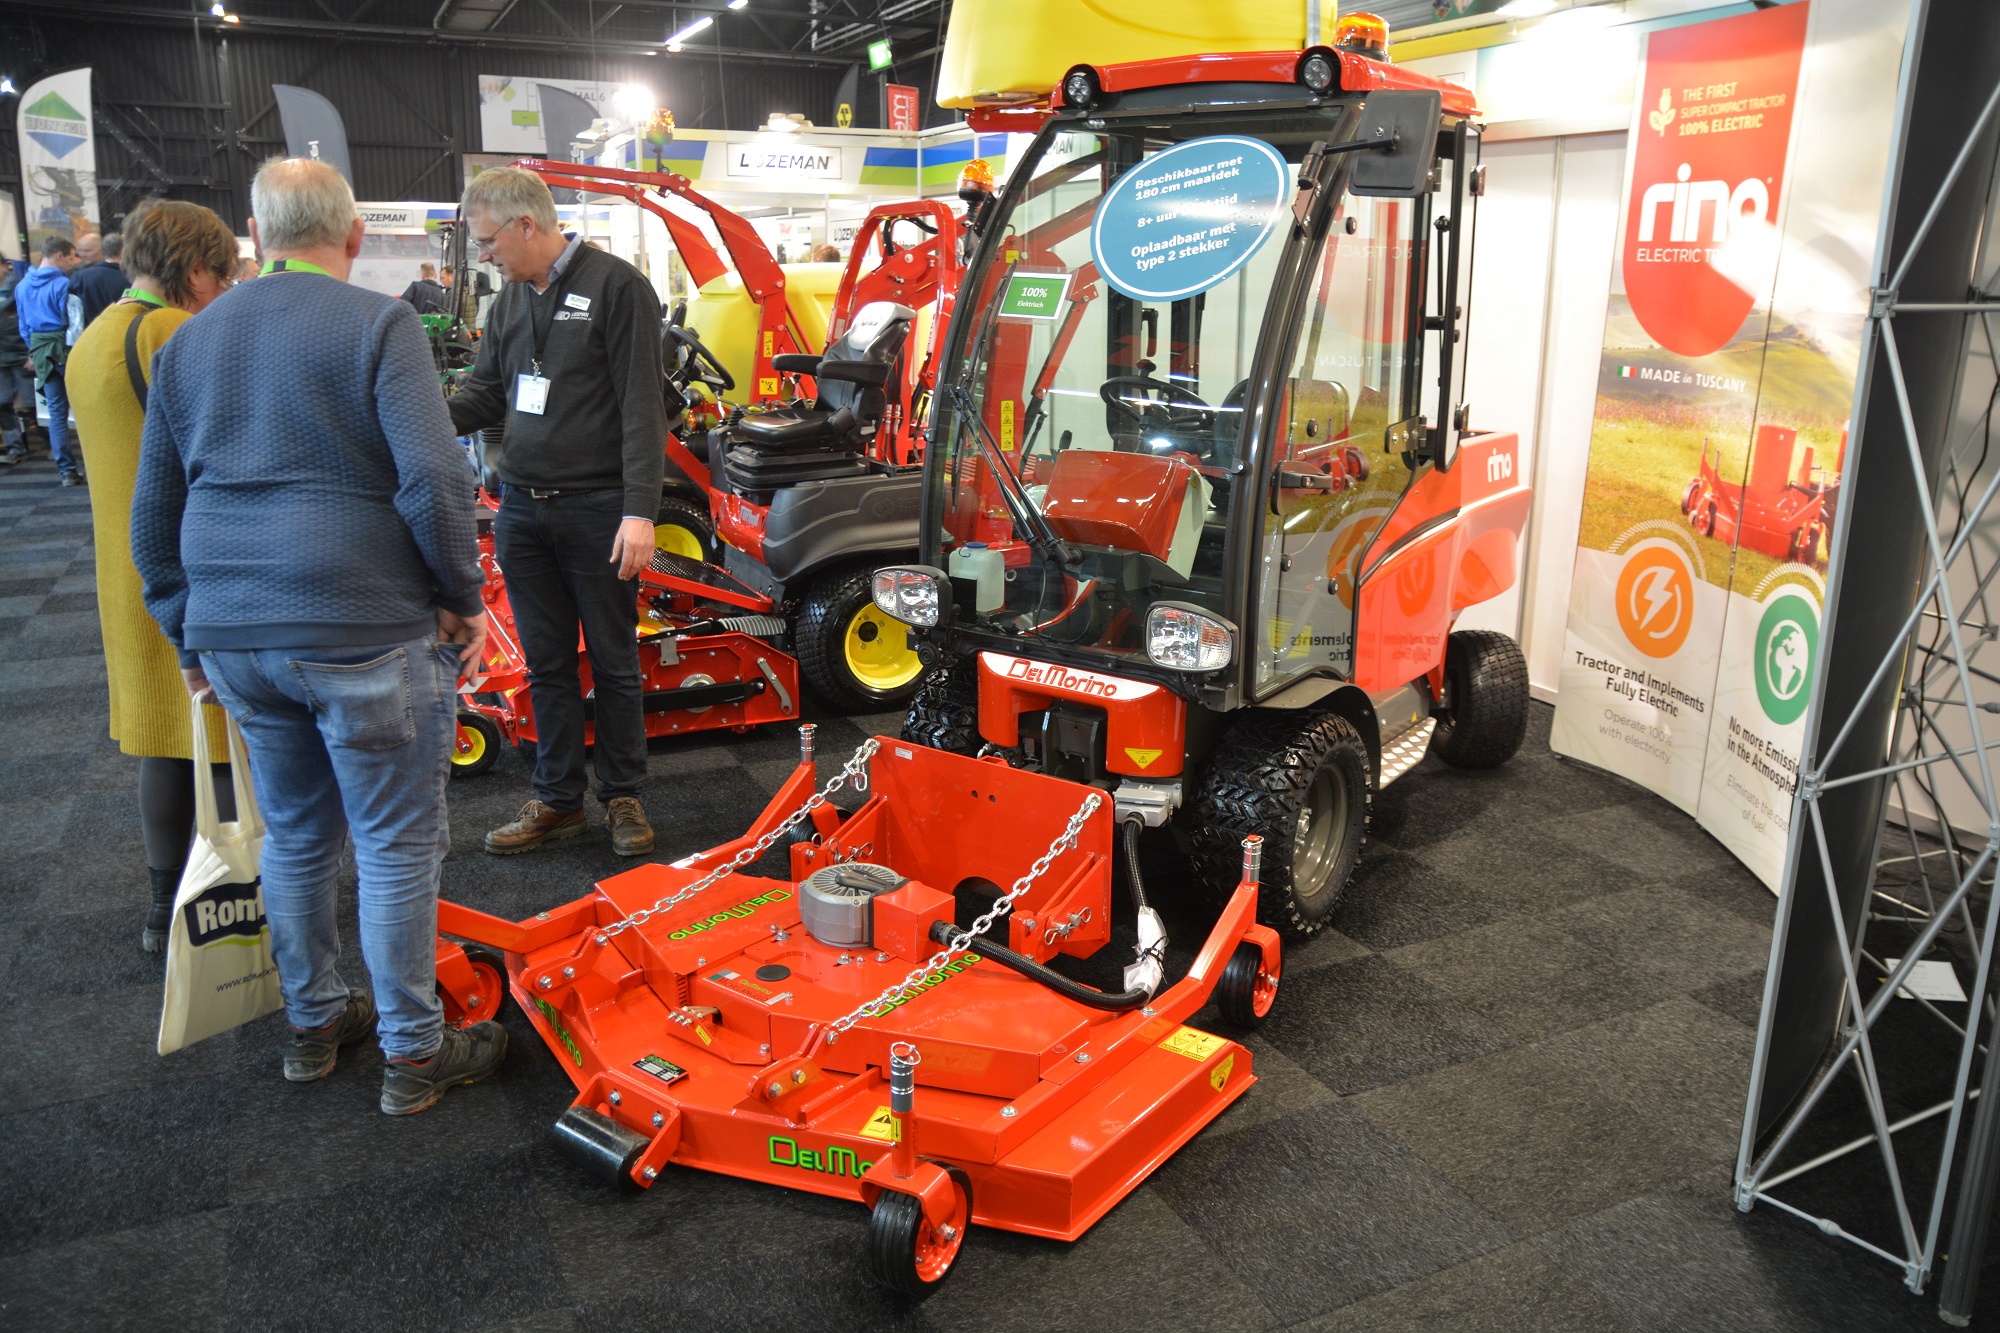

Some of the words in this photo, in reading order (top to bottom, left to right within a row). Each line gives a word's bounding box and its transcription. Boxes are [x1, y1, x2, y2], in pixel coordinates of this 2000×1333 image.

[1680, 104, 1709, 119] SUPER
[1709, 99, 1749, 115] COMPACT
[1749, 94, 1786, 110] TRACTOR
[1682, 87, 1704, 102] THE
[1706, 82, 1738, 99] FIRST
[1679, 120, 1710, 136] 100%
[1711, 113, 1764, 133] ELECTRIC
[1135, 164, 1214, 190] Beschikbaar
[1217, 156, 1243, 169] met
[1135, 187, 1159, 200] 180
[1161, 183, 1181, 195] cm
[1184, 168, 1240, 189] maaidek
[1638, 163, 1769, 242] rino
[1137, 218, 1153, 228] 8+
[1156, 214, 1178, 223] uur
[1131, 230, 1207, 257] Oplaadbaar
[1209, 222, 1237, 237] met
[1136, 255, 1165, 271] type
[1168, 250, 1176, 261] 2
[1179, 237, 1230, 259] stekker
[1637, 248, 1702, 263] ELECTRIC
[1017, 300, 1044, 308] Elektrisch
[1021, 287, 1048, 298] 100%
[1640, 367, 1681, 384] MADE
[1683, 373, 1693, 384] in
[1696, 373, 1747, 392] TUSCANY
[1487, 448, 1512, 482] rino
[1576, 651, 1622, 675] Tractor
[1623, 668, 1646, 684] and
[1647, 674, 1705, 713] Implements
[1606, 677, 1637, 701] Fully
[1639, 688, 1679, 717] Electric
[1599, 724, 1622, 740] with
[1624, 734, 1672, 764] electricity.
[1604, 709, 1647, 734] Operate
[1649, 725, 1673, 747] 100%
[1729, 715, 1741, 735] No
[1742, 728, 1764, 752] more
[1765, 741, 1800, 775] Emissio
[1727, 734, 1736, 752] in
[1737, 741, 1751, 763] the
[1752, 753, 1796, 797] Atmosphe
[1727, 774, 1759, 808] Eliminate
[1761, 801, 1773, 819] the
[1742, 809, 1751, 820] of
